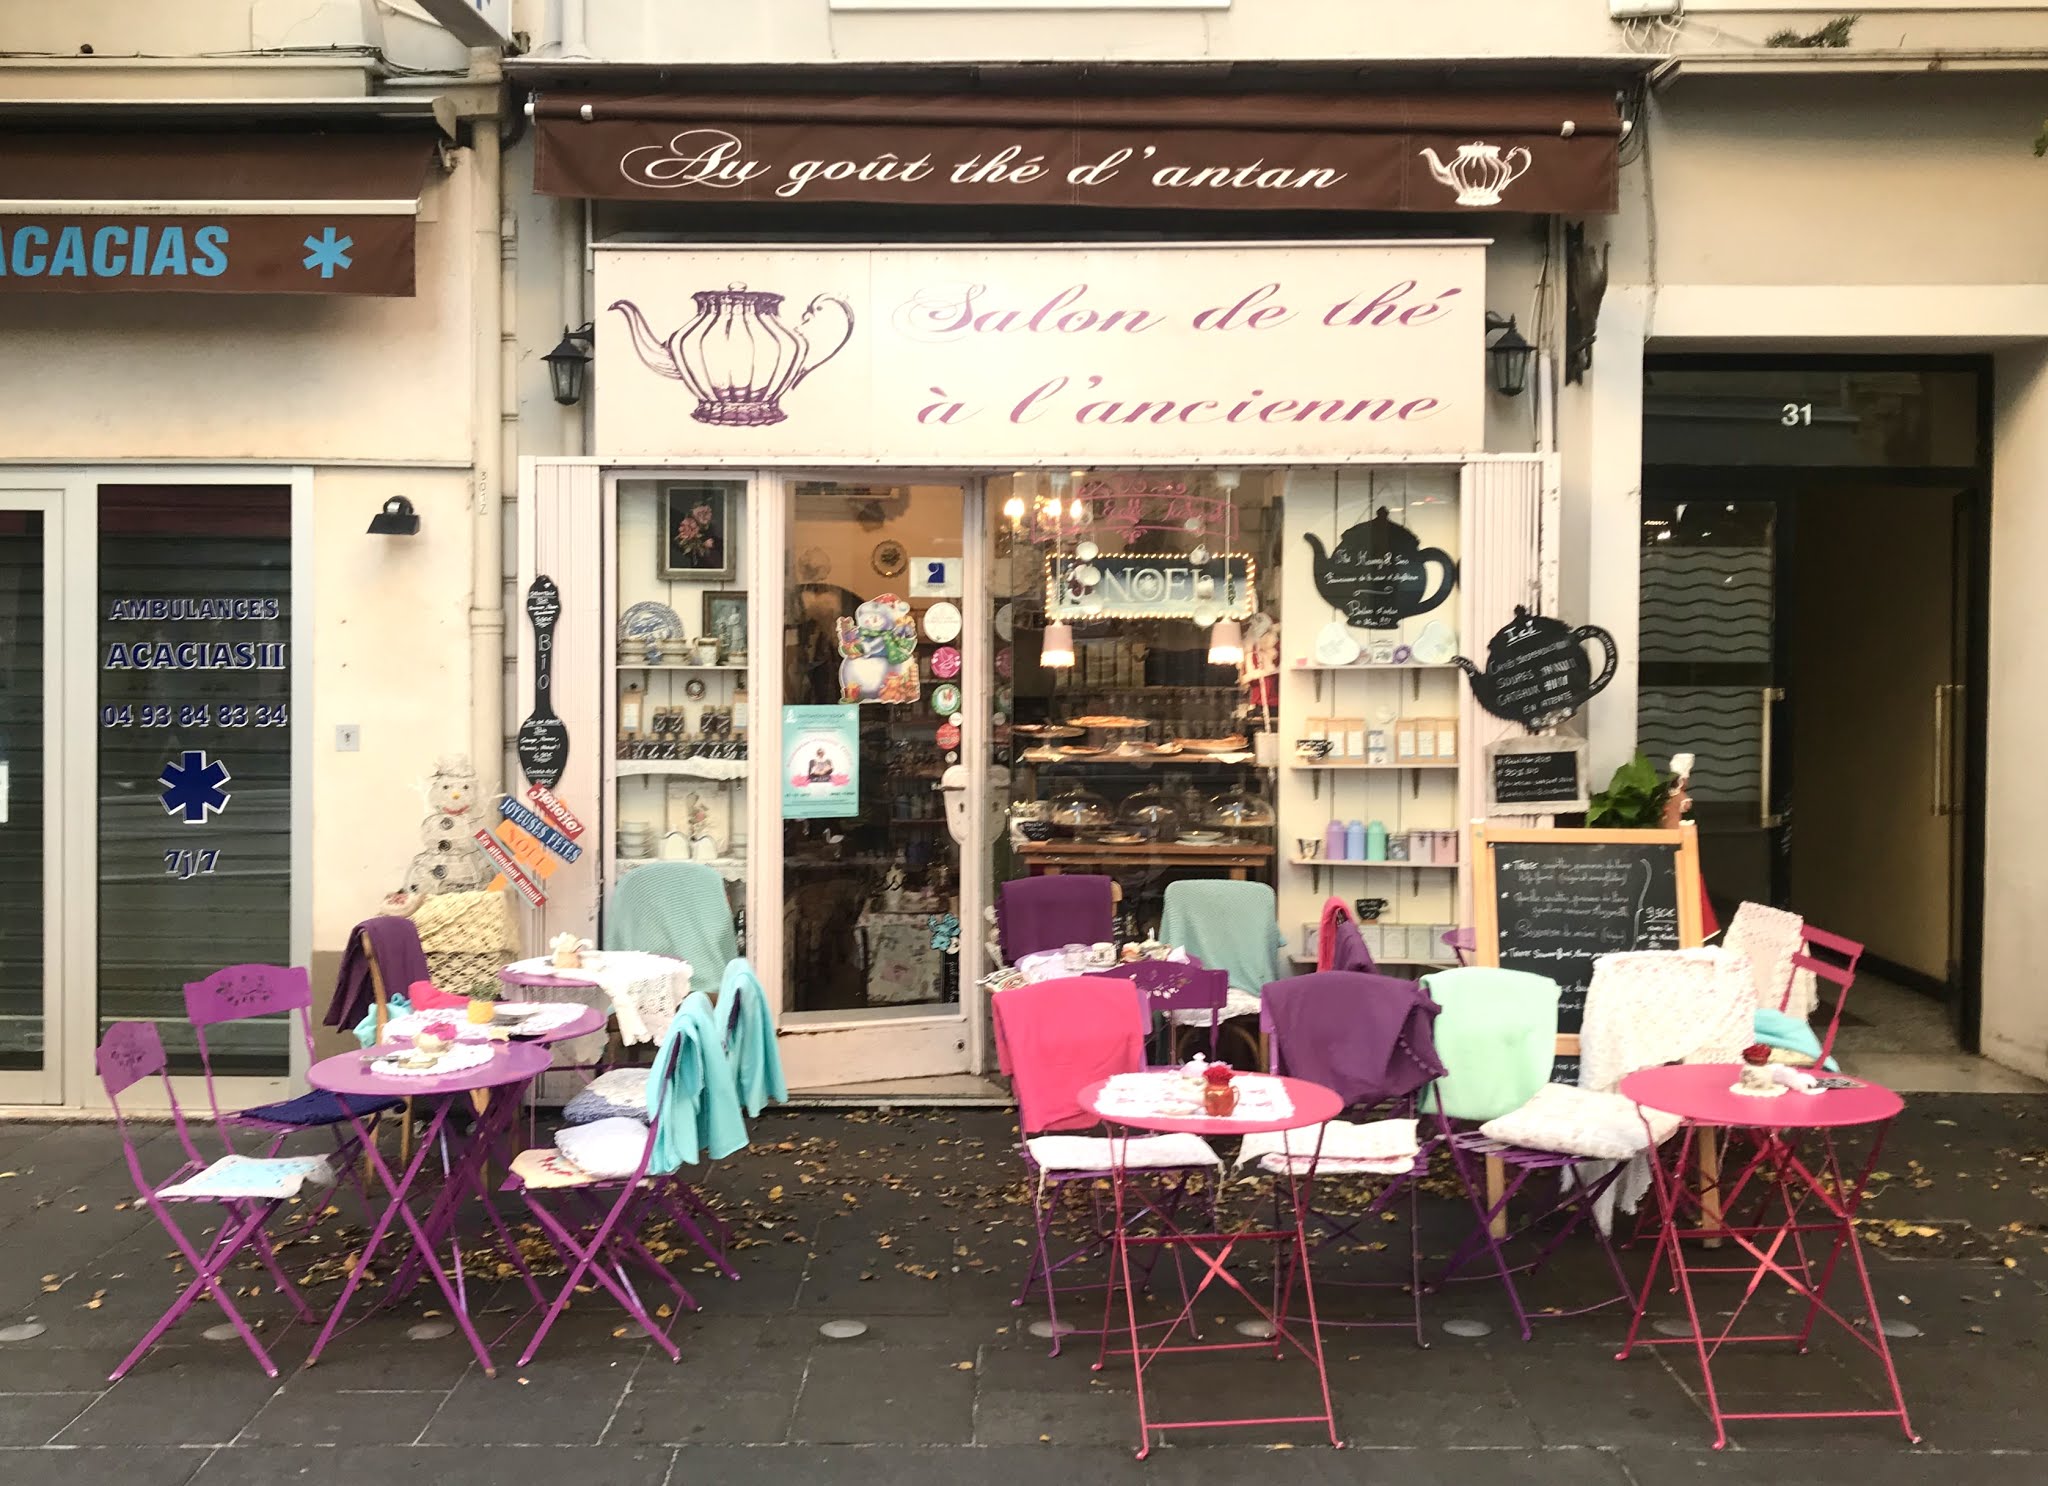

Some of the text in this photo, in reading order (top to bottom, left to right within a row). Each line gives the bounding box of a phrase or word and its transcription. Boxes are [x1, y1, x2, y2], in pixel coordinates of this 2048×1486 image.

[620, 129, 1348, 197] Au goût thé d'antan
[0, 225, 229, 278] CACIAS
[893, 279, 1462, 343] Salon de thé
[917, 375, 1452, 425] à l'ancienne
[1781, 402, 1813, 427] 31
[108, 598, 280, 621] AMBULANCES
[1504, 620, 1538, 642] Ici
[102, 703, 288, 728] 04 93 84 83 34
[500, 798, 549, 838] JOYEUSES
[163, 849, 220, 880] 7j/7
[487, 844, 521, 879] attendant
[517, 878, 543, 904] minuit
